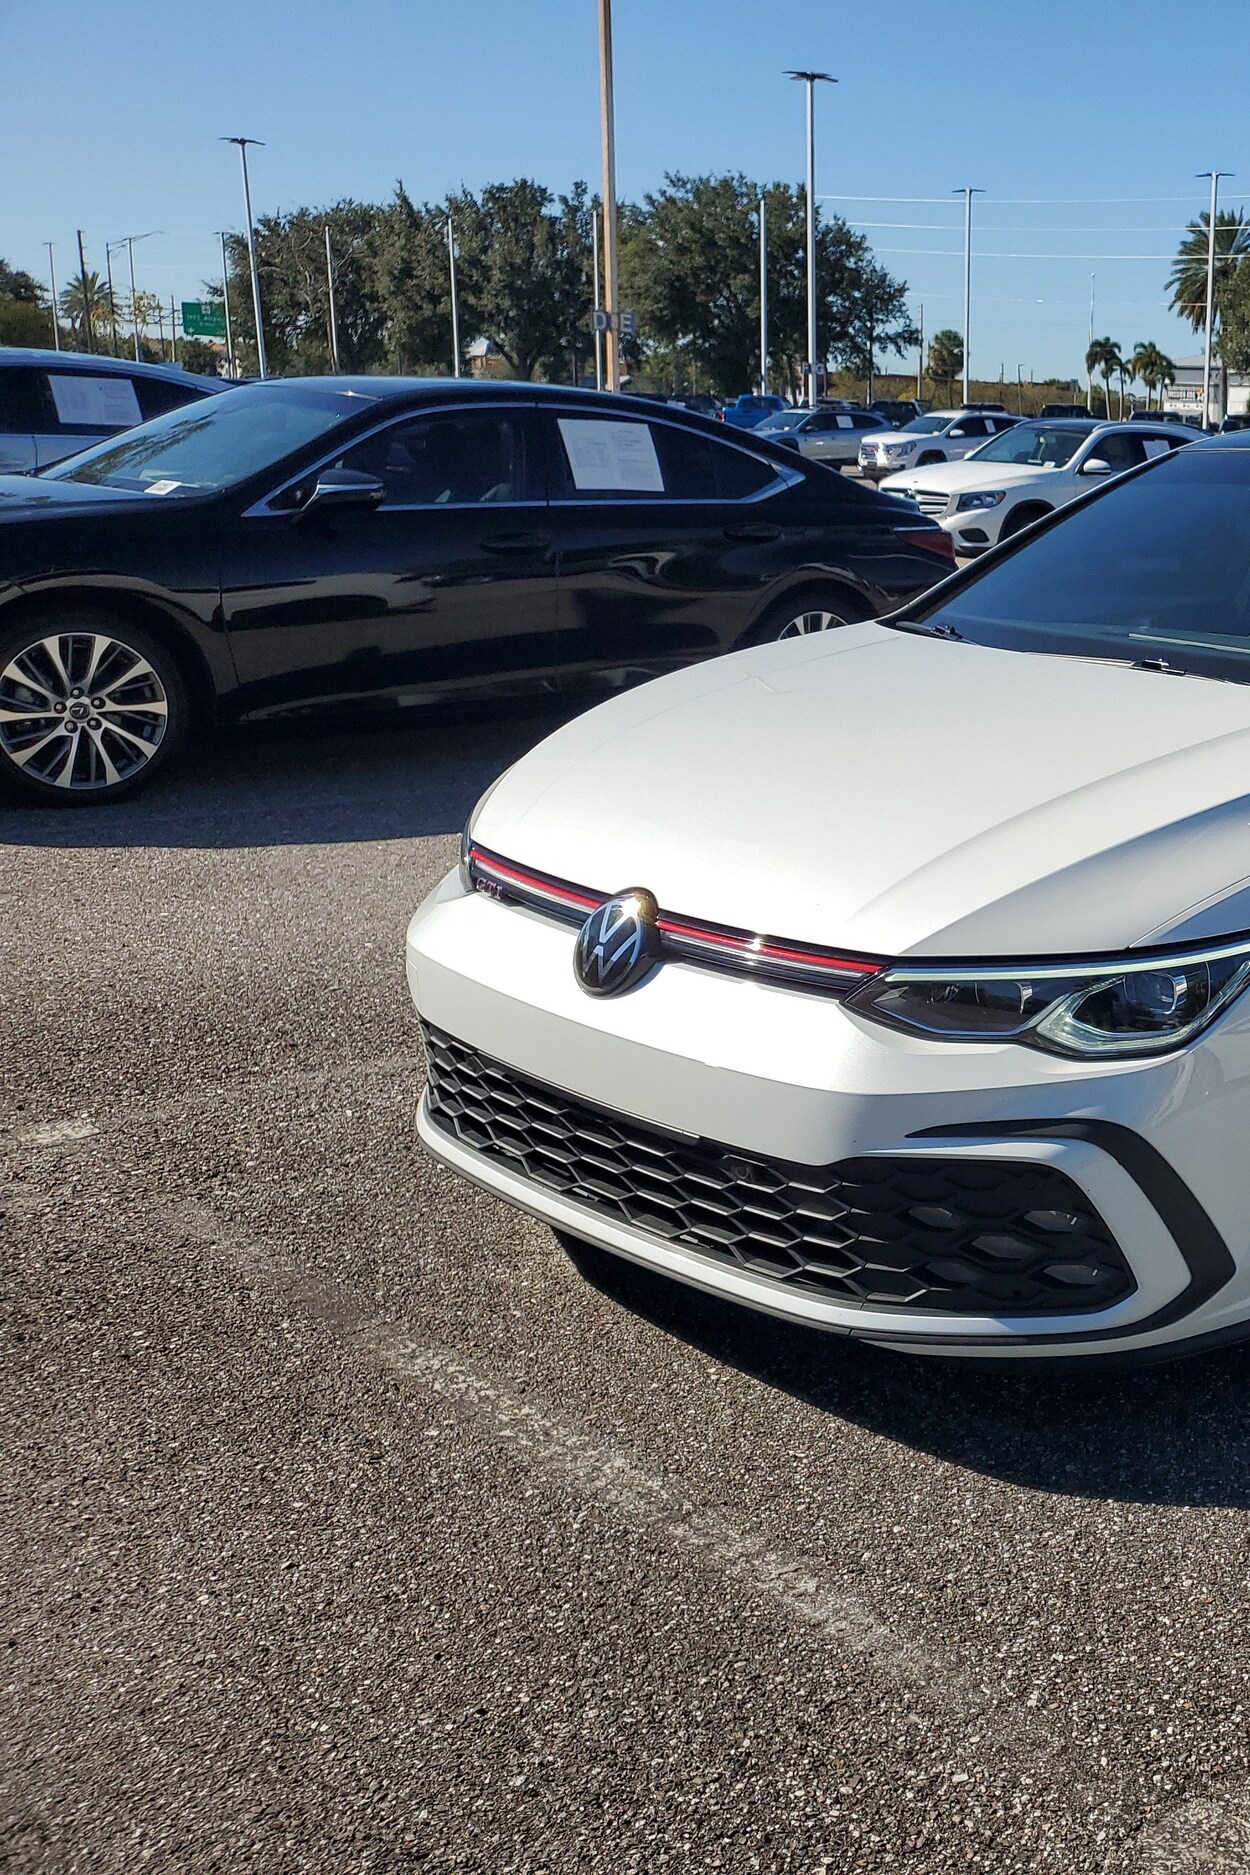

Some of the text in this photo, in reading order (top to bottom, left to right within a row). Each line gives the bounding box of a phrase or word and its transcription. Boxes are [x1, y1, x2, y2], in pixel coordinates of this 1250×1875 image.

[593, 311, 607, 330] D
[620, 314, 632, 333] E
[475, 877, 504, 901] GTI
